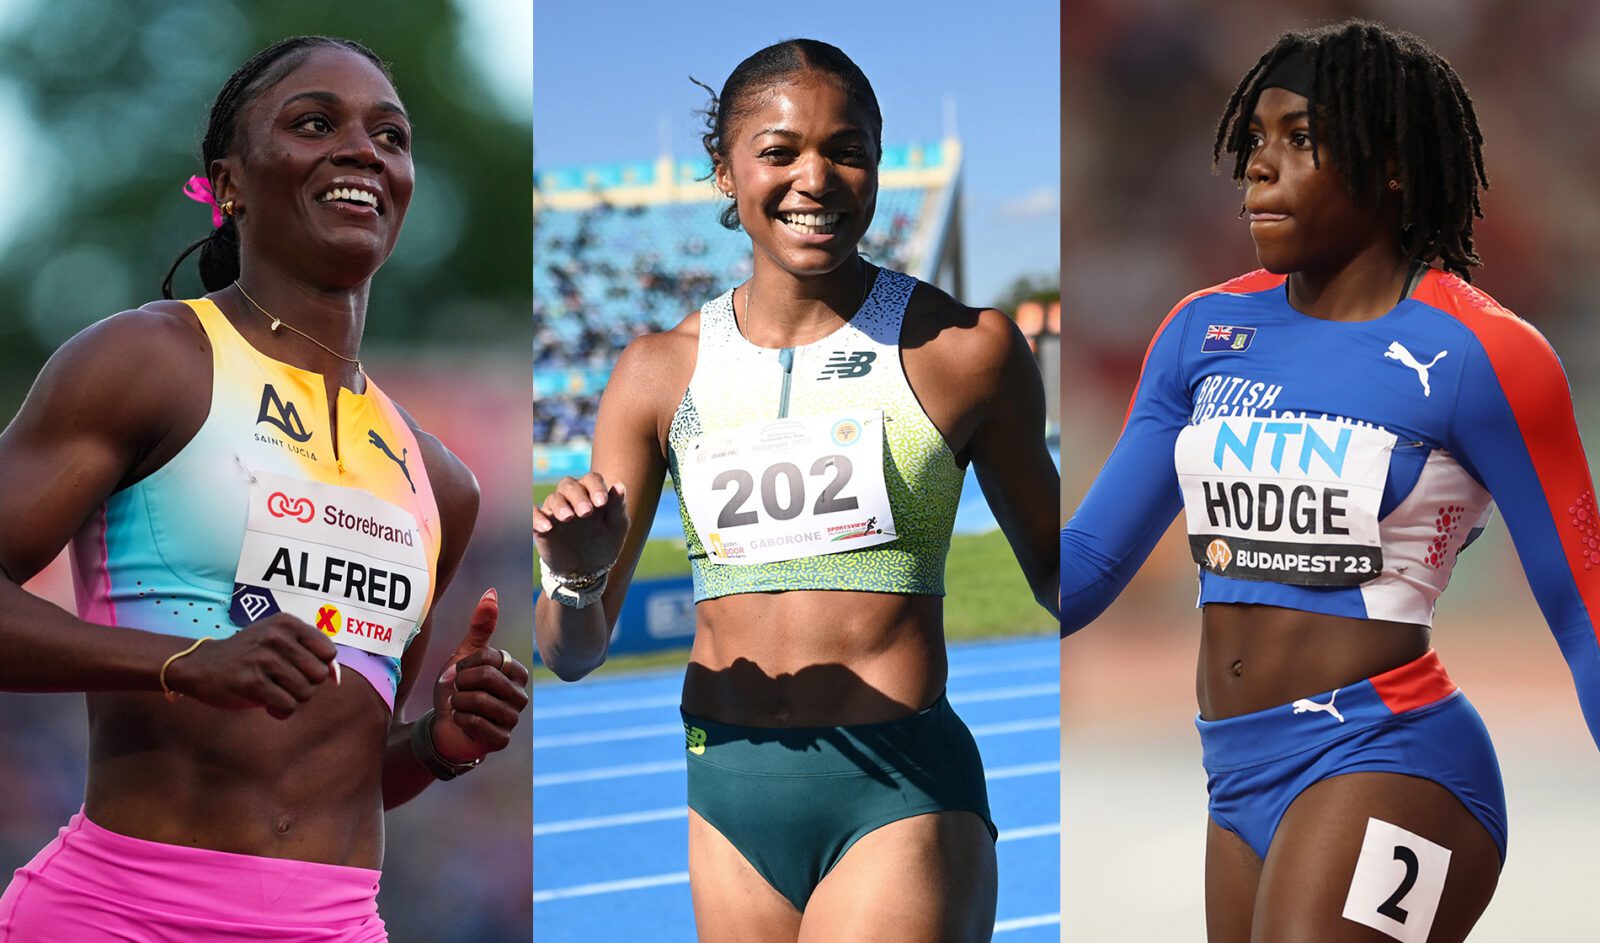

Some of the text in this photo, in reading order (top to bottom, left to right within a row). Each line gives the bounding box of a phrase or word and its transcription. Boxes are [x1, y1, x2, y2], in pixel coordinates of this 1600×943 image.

[1197, 375, 1283, 410] BRITISH
[254, 433, 317, 461] SAINT LUCIA
[1213, 420, 1353, 479] NTN
[711, 454, 859, 529] 202
[1202, 481, 1350, 536] HODGE
[323, 505, 414, 547] Storebrand
[750, 530, 823, 550] GABORONE
[724, 547, 745, 555] DOOR
[1236, 552, 1372, 574] BUDAPEST 23
[262, 547, 412, 612] ALFRED
[346, 617, 393, 643] EXTRA
[1376, 845, 1419, 925] 2
